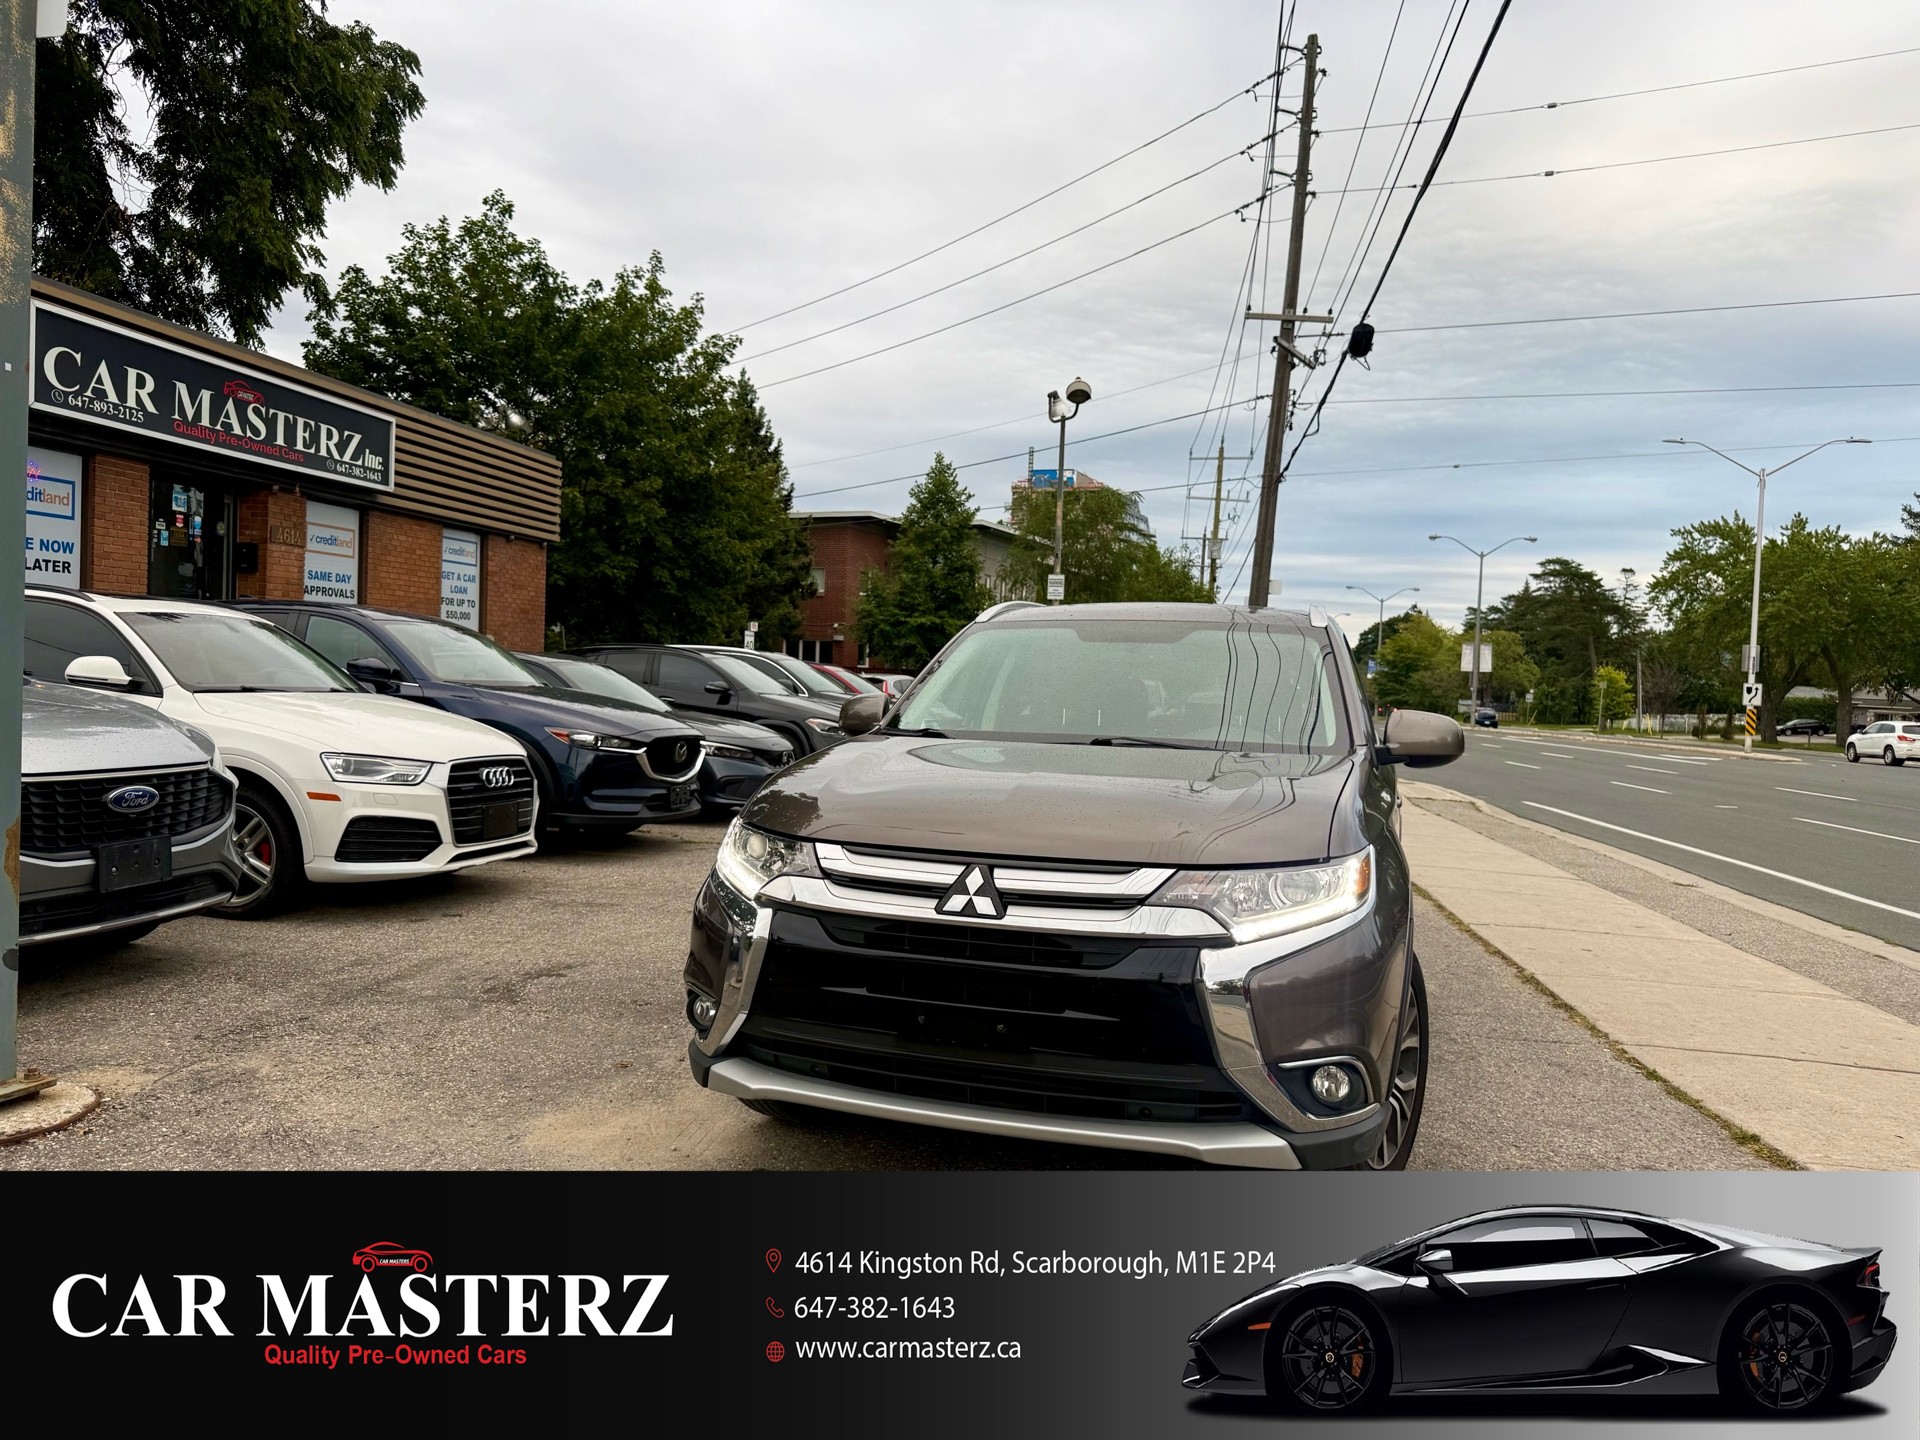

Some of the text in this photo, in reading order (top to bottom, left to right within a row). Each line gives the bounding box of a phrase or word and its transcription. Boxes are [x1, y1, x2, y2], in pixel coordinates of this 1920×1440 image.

[43, 346, 385, 471] CAR MASTERZ Inc.
[68, 393, 144, 423] 647-893-2125
[174, 421, 304, 462] Quality Pre-Owned Cars
[336, 463, 382, 482] 647-382-1643
[26, 486, 70, 507] ditland
[276, 527, 301, 545] 4614
[315, 534, 353, 549] creditland
[39, 538, 75, 555] NOW
[25, 557, 72, 574] LATER
[307, 569, 352, 585] SAME DAY
[442, 571, 455, 581] GET
[463, 574, 476, 584] CAR
[304, 585, 355, 600] APPROVALS
[450, 584, 468, 595] LOAN
[442, 597, 476, 609] FOR UP TO
[446, 610, 471, 621] $50,000
[121, 791, 150, 807] Ford
